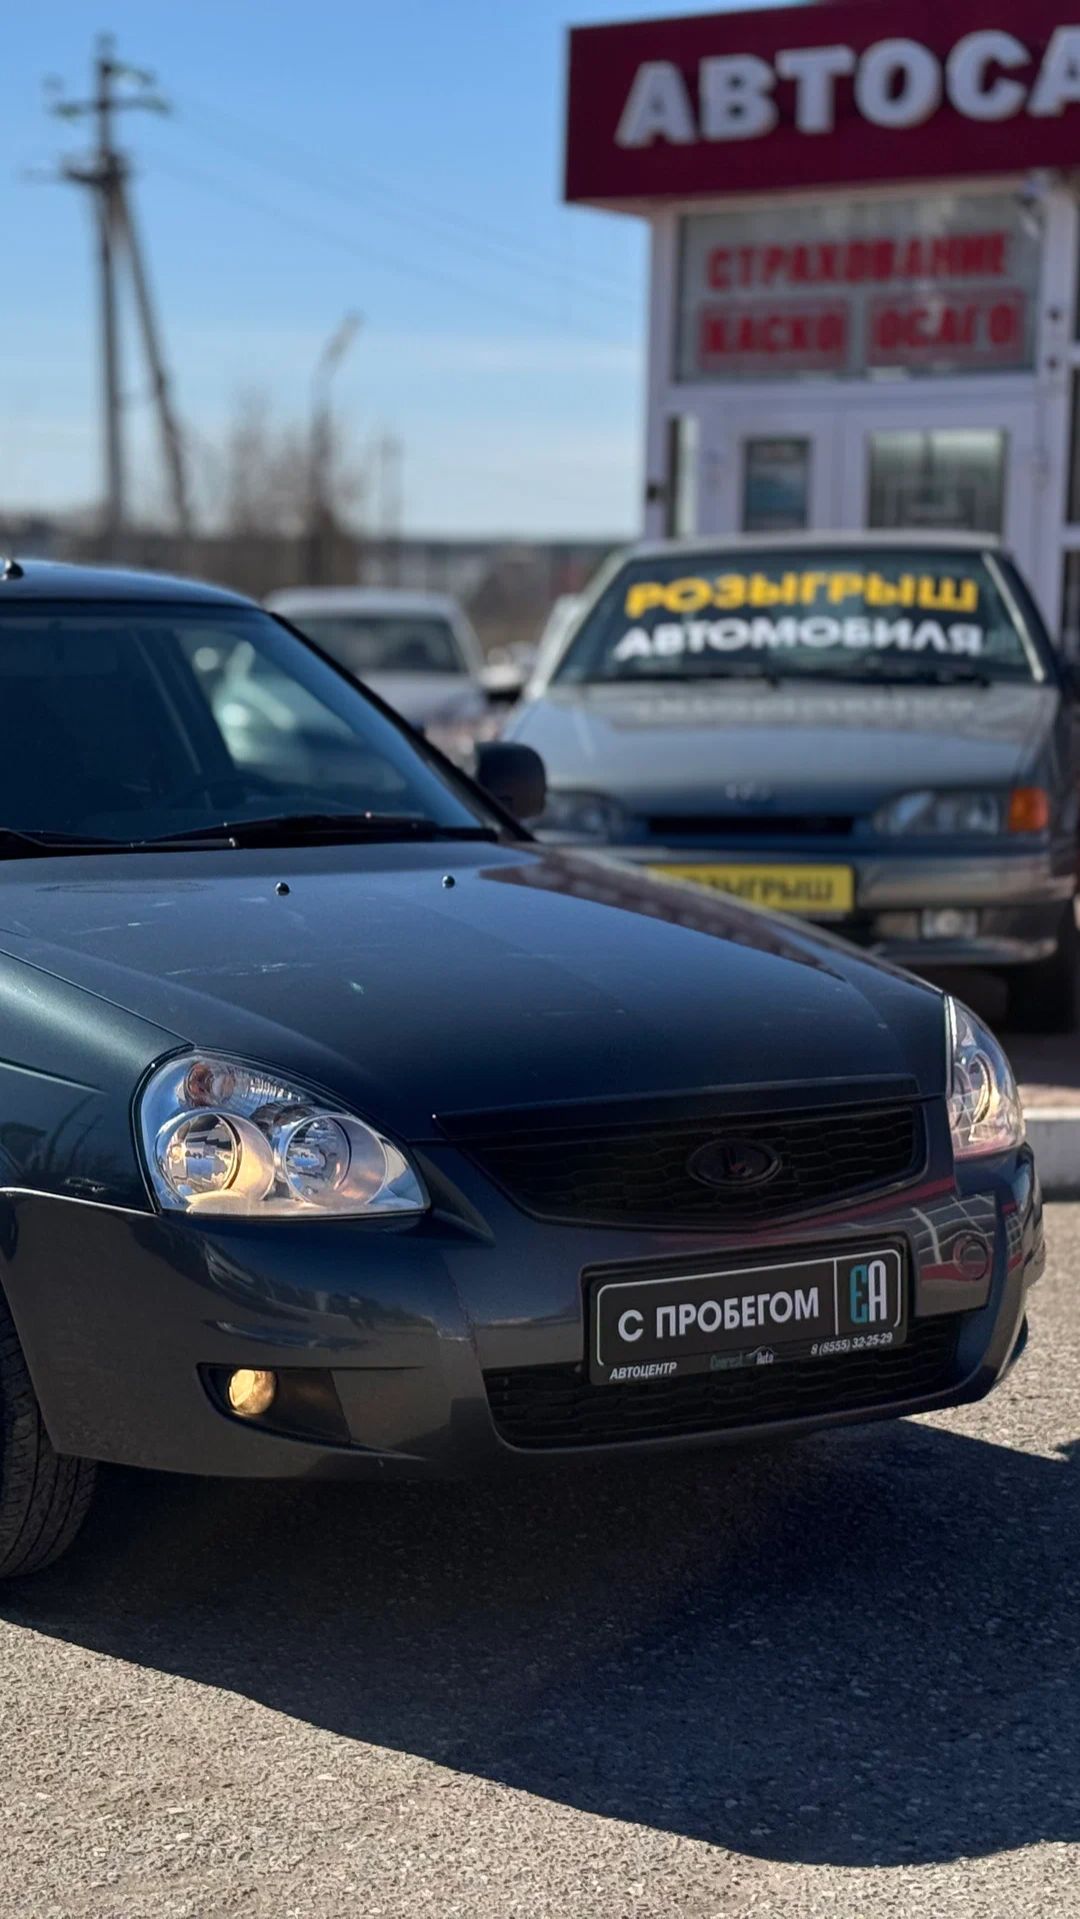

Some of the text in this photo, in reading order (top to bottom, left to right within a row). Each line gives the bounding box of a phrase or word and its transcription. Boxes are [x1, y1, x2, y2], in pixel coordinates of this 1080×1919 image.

[614, 24, 1080, 149] АВТОСА
[707, 231, 1009, 291] СТРАХОВАНИЕ
[702, 309, 845, 356] КАСКО
[873, 301, 1019, 351] ОСАГО
[625, 571, 979, 620] РОЗЫГРЫШ
[613, 615, 984, 662] АВТОМОБИЛЯ
[688, 874, 834, 901] ЫГРЫШ
[618, 1286, 820, 1343] С ПРОБЕГОМ
[810, 1331, 894, 1356] 8 (8555) 32-25-29
[609, 1360, 678, 1381] АВТОЦЕНТР
